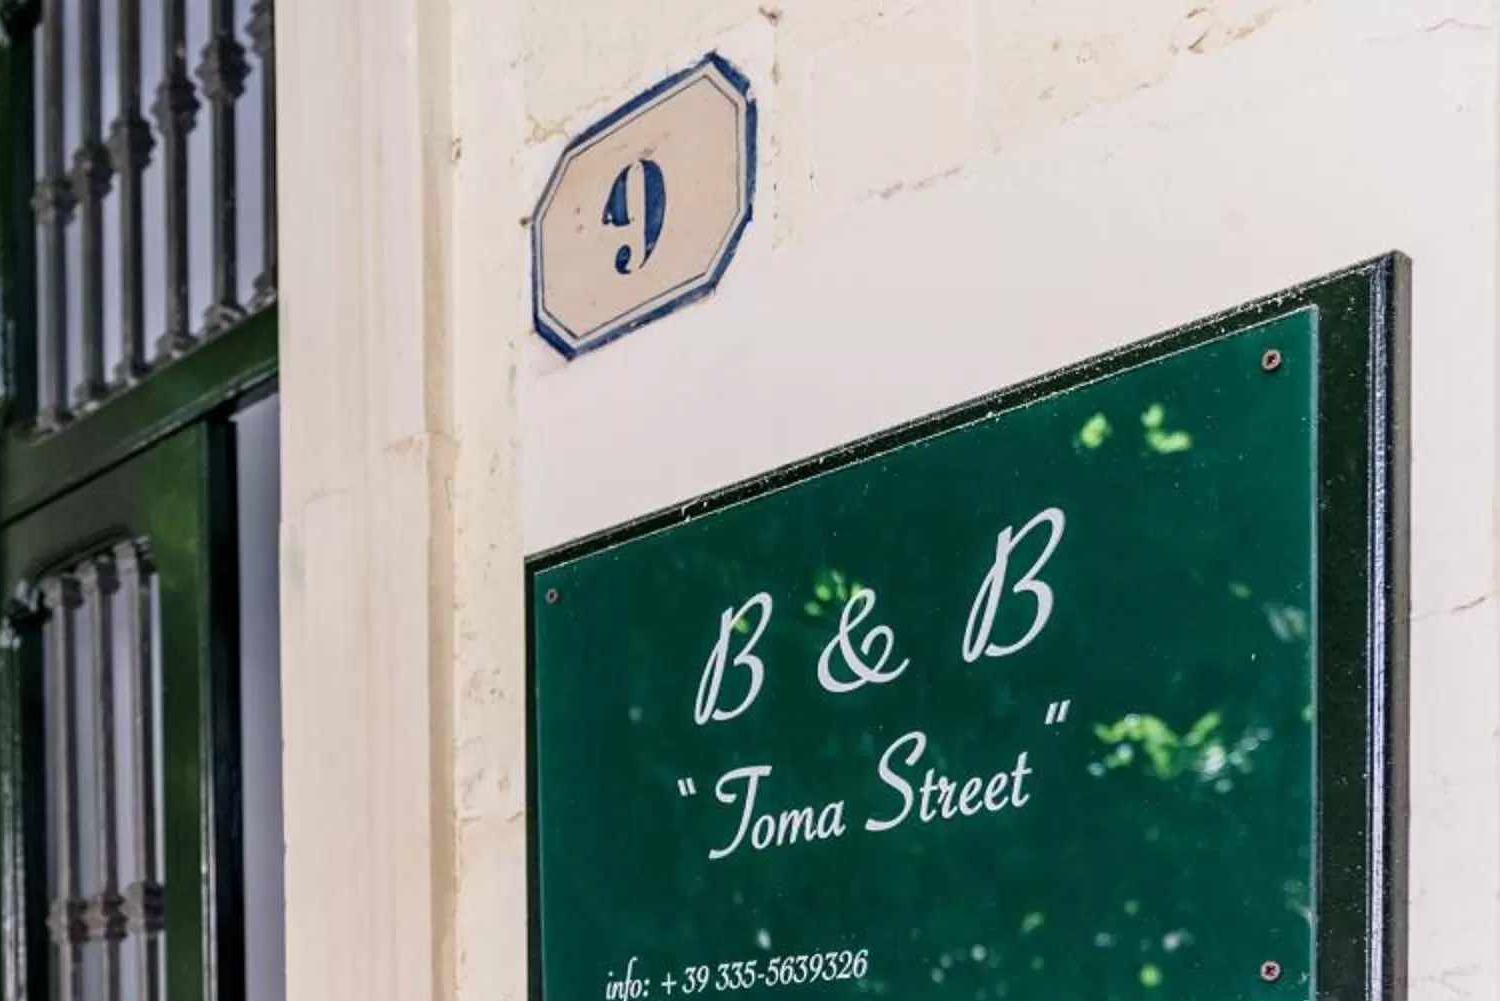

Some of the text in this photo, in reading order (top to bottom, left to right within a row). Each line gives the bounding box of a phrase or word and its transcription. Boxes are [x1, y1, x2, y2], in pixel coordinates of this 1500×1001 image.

[601, 157, 667, 275] 9
[693, 506, 1066, 726] B & B
[714, 948, 869, 992] 335-5639326
